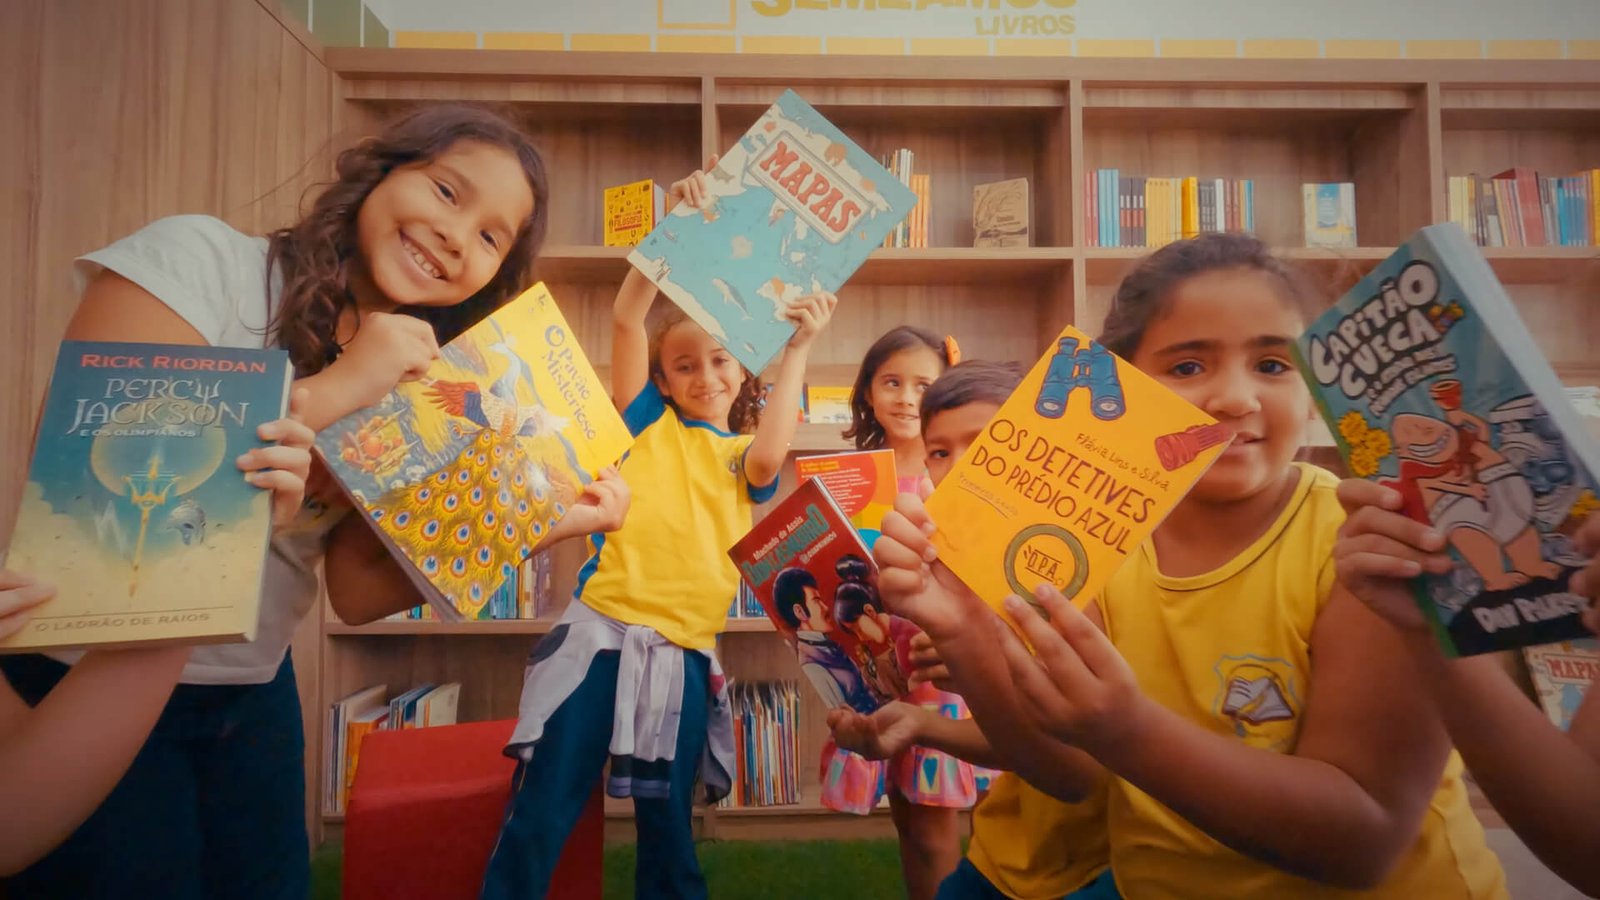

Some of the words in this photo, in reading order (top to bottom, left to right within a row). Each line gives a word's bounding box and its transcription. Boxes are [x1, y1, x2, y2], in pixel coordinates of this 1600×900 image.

[975, 15, 1076, 35] LIVROS
[759, 141, 862, 233] MAPAS
[544, 324, 565, 347] O
[81, 353, 144, 369] RICK
[152, 355, 266, 374] RIORDAN
[1340, 309, 1443, 399] CUECA
[104, 377, 222, 402] PERCY
[66, 398, 249, 434] JACKSON
[80, 428, 89, 437] E
[92, 428, 112, 437] OS
[114, 428, 196, 438] OLIMPIANOS
[989, 419, 1028, 452] OS
[1025, 436, 1156, 524] DETETIVES
[971, 445, 1007, 477] DO
[1005, 466, 1076, 518] PRÉDIO
[1073, 506, 1130, 555] AZUL
[35, 622, 48, 632] O
[54, 615, 125, 631] LADRÃO
[129, 616, 153, 627] DE
[158, 612, 211, 625] RAIOS
